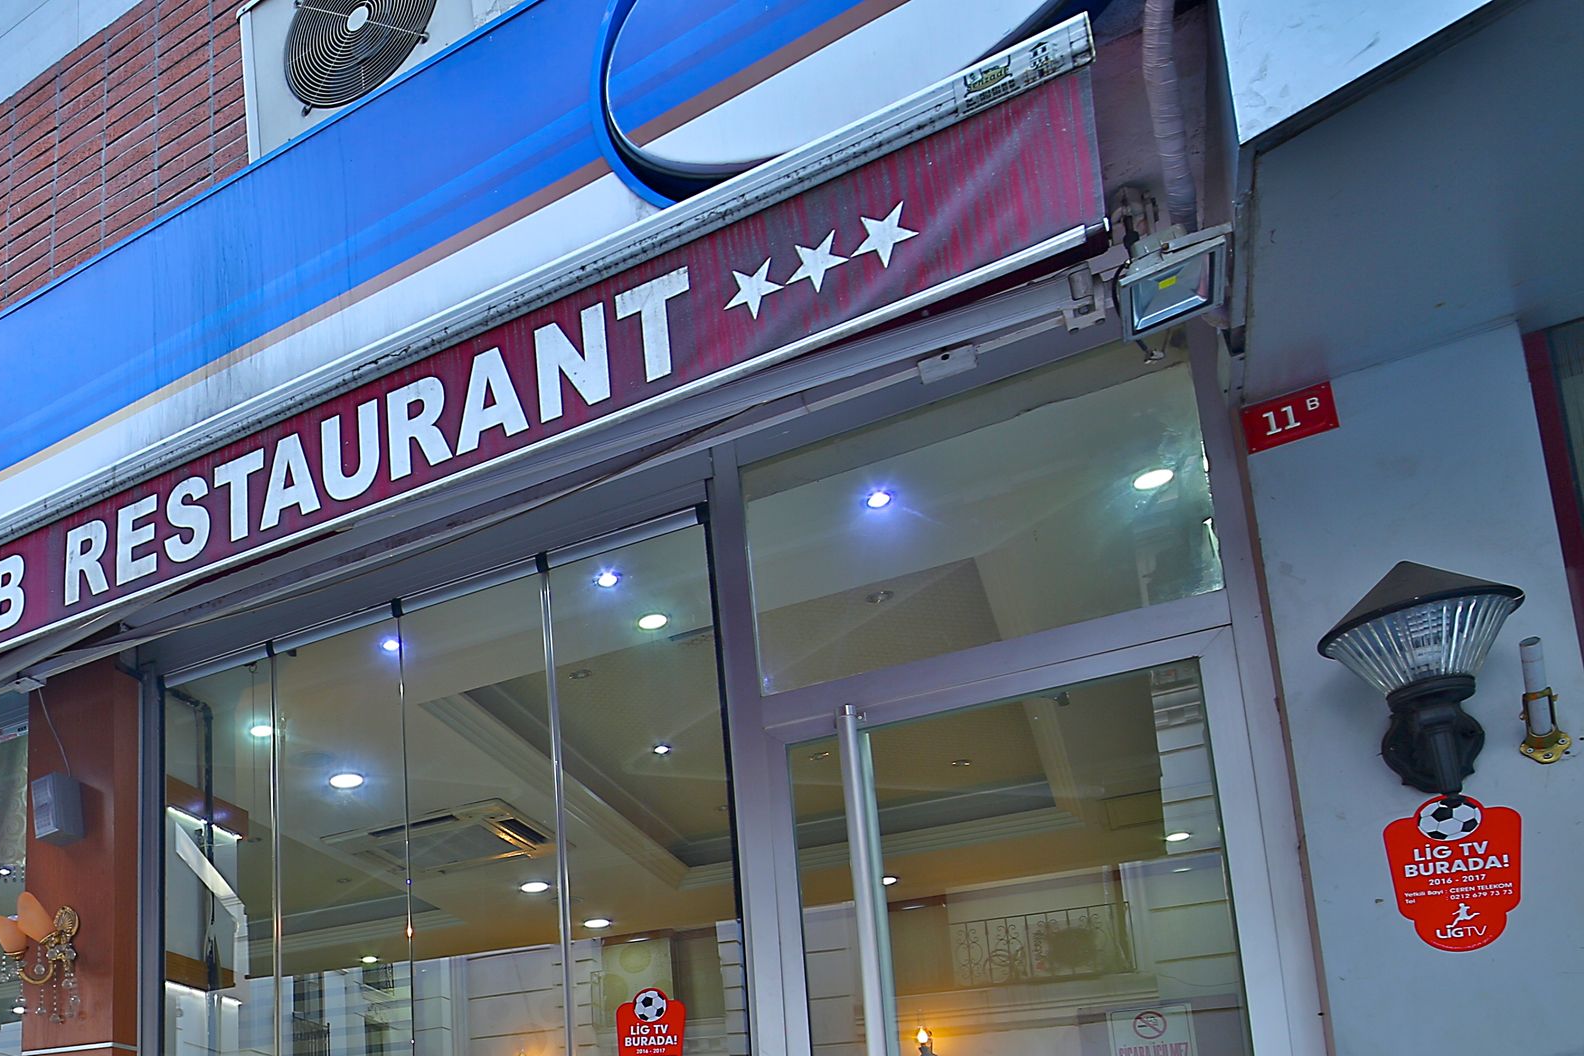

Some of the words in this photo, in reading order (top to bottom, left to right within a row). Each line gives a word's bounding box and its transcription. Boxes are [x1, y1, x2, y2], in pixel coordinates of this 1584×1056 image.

[1262, 405, 1301, 436] 11
[1306, 397, 1320, 411] B
[64, 266, 690, 606] RESTAURANT
[1459, 841, 1488, 856] TV
[1404, 854, 1510, 877] BURADA!
[1428, 878, 1453, 886] 2016
[1462, 874, 1486, 883] 2017
[1449, 886, 1475, 894] CEREN
[1477, 882, 1513, 891] TELEKOM
[653, 1024, 668, 1034] TV
[624, 1035, 677, 1047] BURADA!
